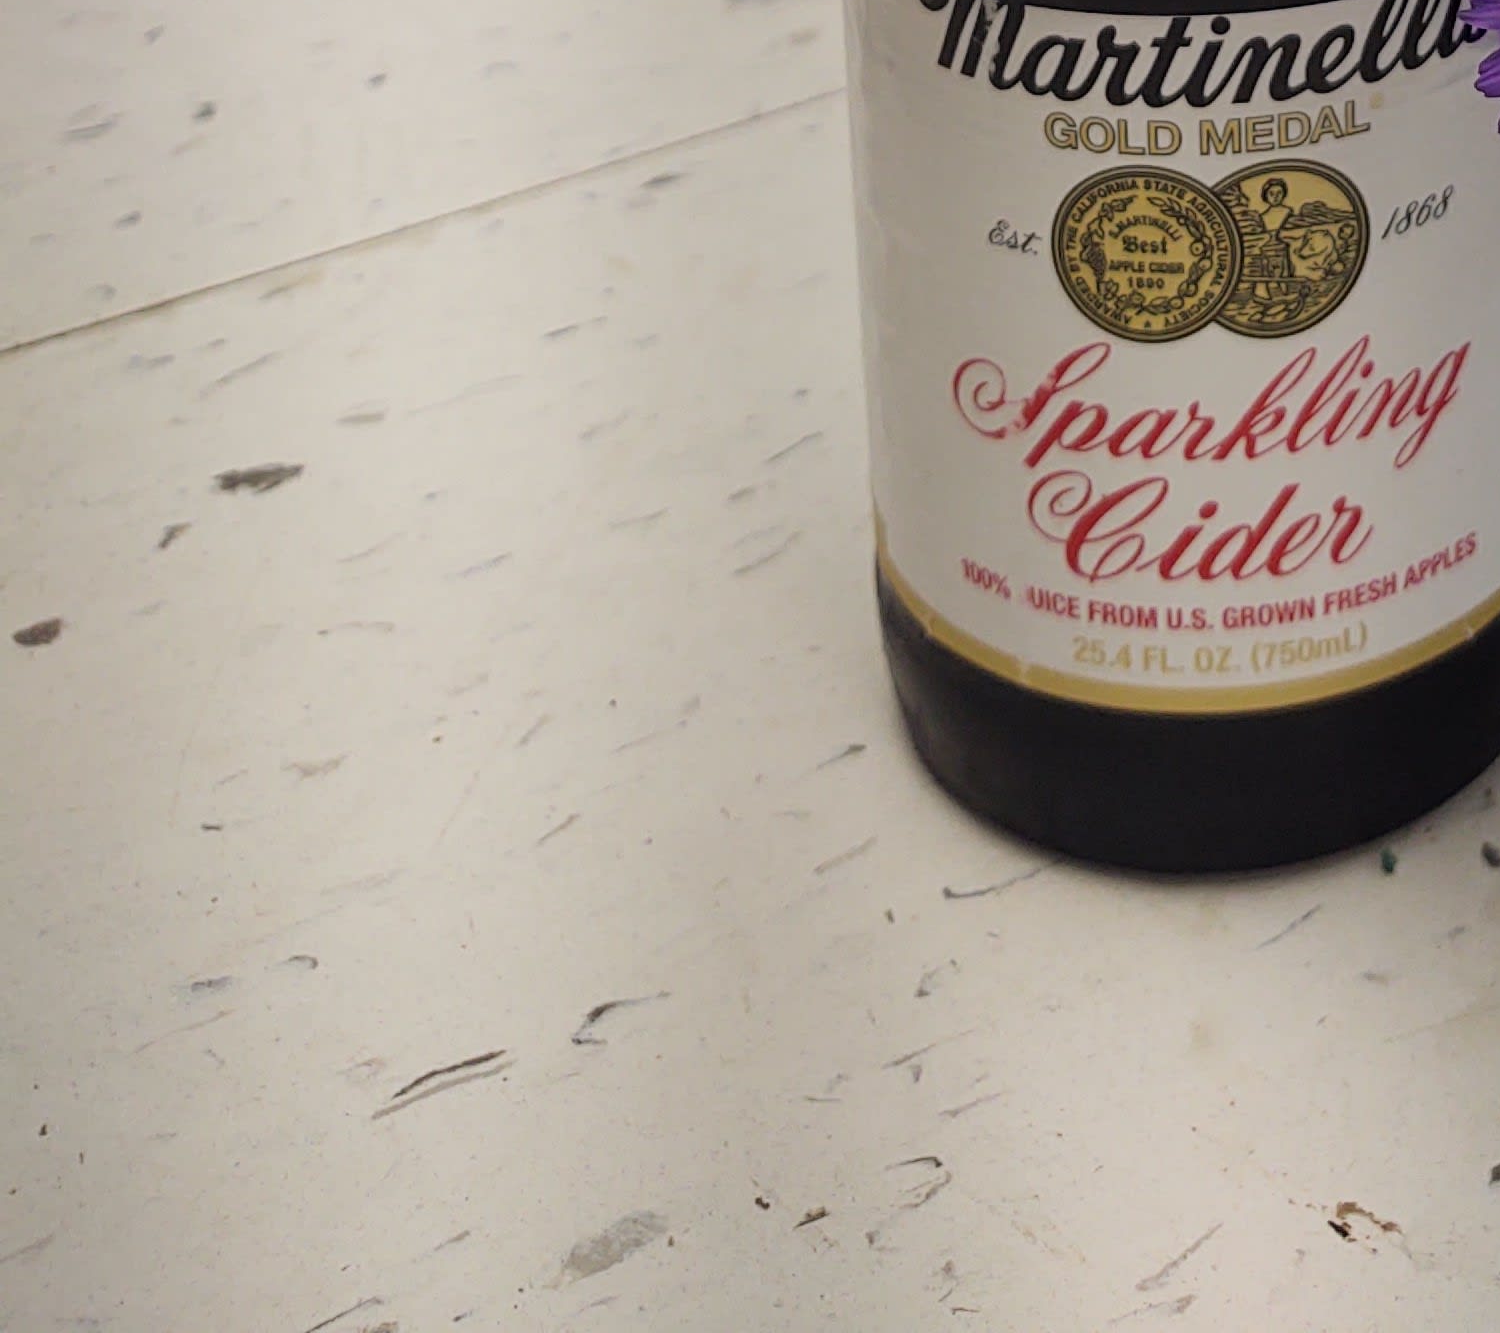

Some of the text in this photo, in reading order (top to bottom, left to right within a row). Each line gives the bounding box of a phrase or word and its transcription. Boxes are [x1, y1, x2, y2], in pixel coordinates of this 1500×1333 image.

[1043, 100, 1372, 157] GOLD MEDAL
[988, 219, 1042, 256] Est.
[1071, 179, 1139, 224] CALIFORNIA
[1143, 179, 1187, 201] STATE
[1187, 196, 1229, 287] AGRICULTURAL
[1380, 184, 1455, 240] 1868
[1108, 260, 1145, 274] APPLE
[1122, 235, 1169, 255] Best
[953, 334, 1472, 469] Sparkling
[1028, 469, 1374, 584] Cider
[960, 530, 1477, 631] 100% UICE FROM U.S. GROWN FRESH APPLES
[1072, 620, 1369, 676] 25.4 FL. OZ. (750mL)
